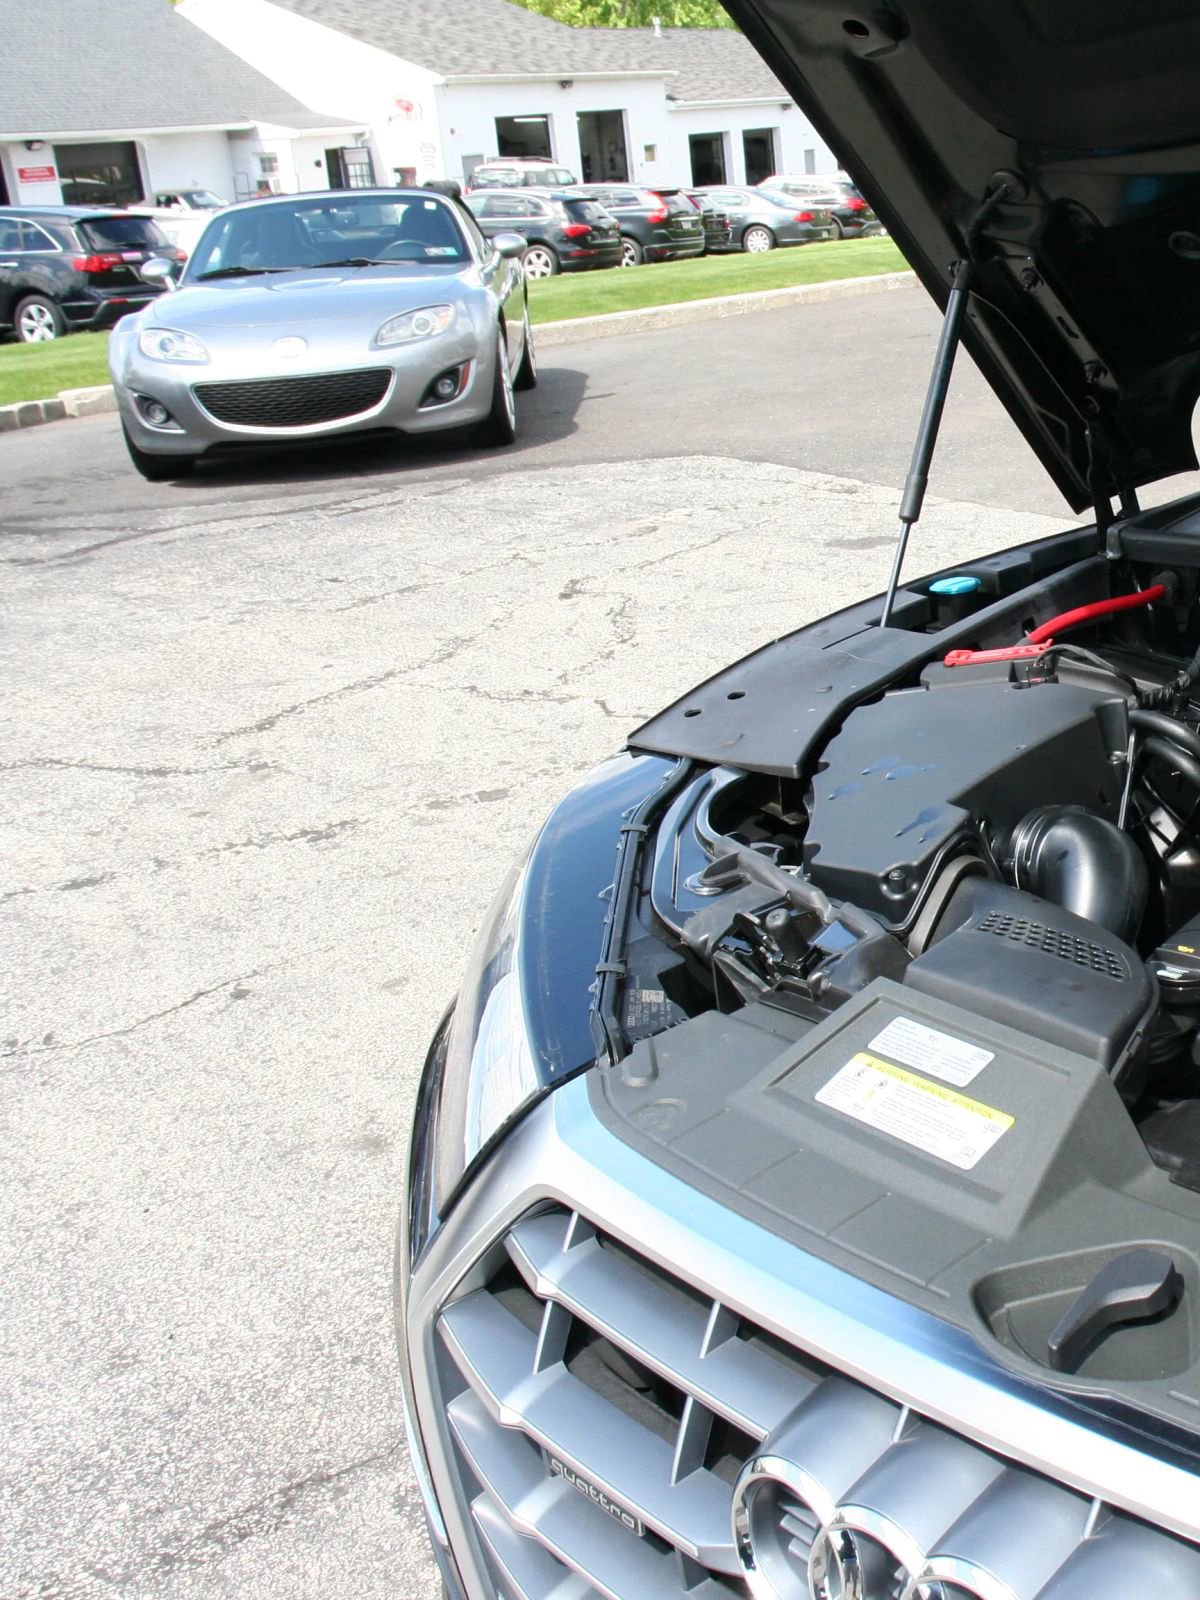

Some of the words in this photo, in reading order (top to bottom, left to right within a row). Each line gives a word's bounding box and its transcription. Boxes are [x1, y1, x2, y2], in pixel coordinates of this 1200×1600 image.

[913, 1079, 949, 1100] WARNING
[952, 1097, 993, 1119] ATTENTION
[550, 1457, 634, 1529] quattro
